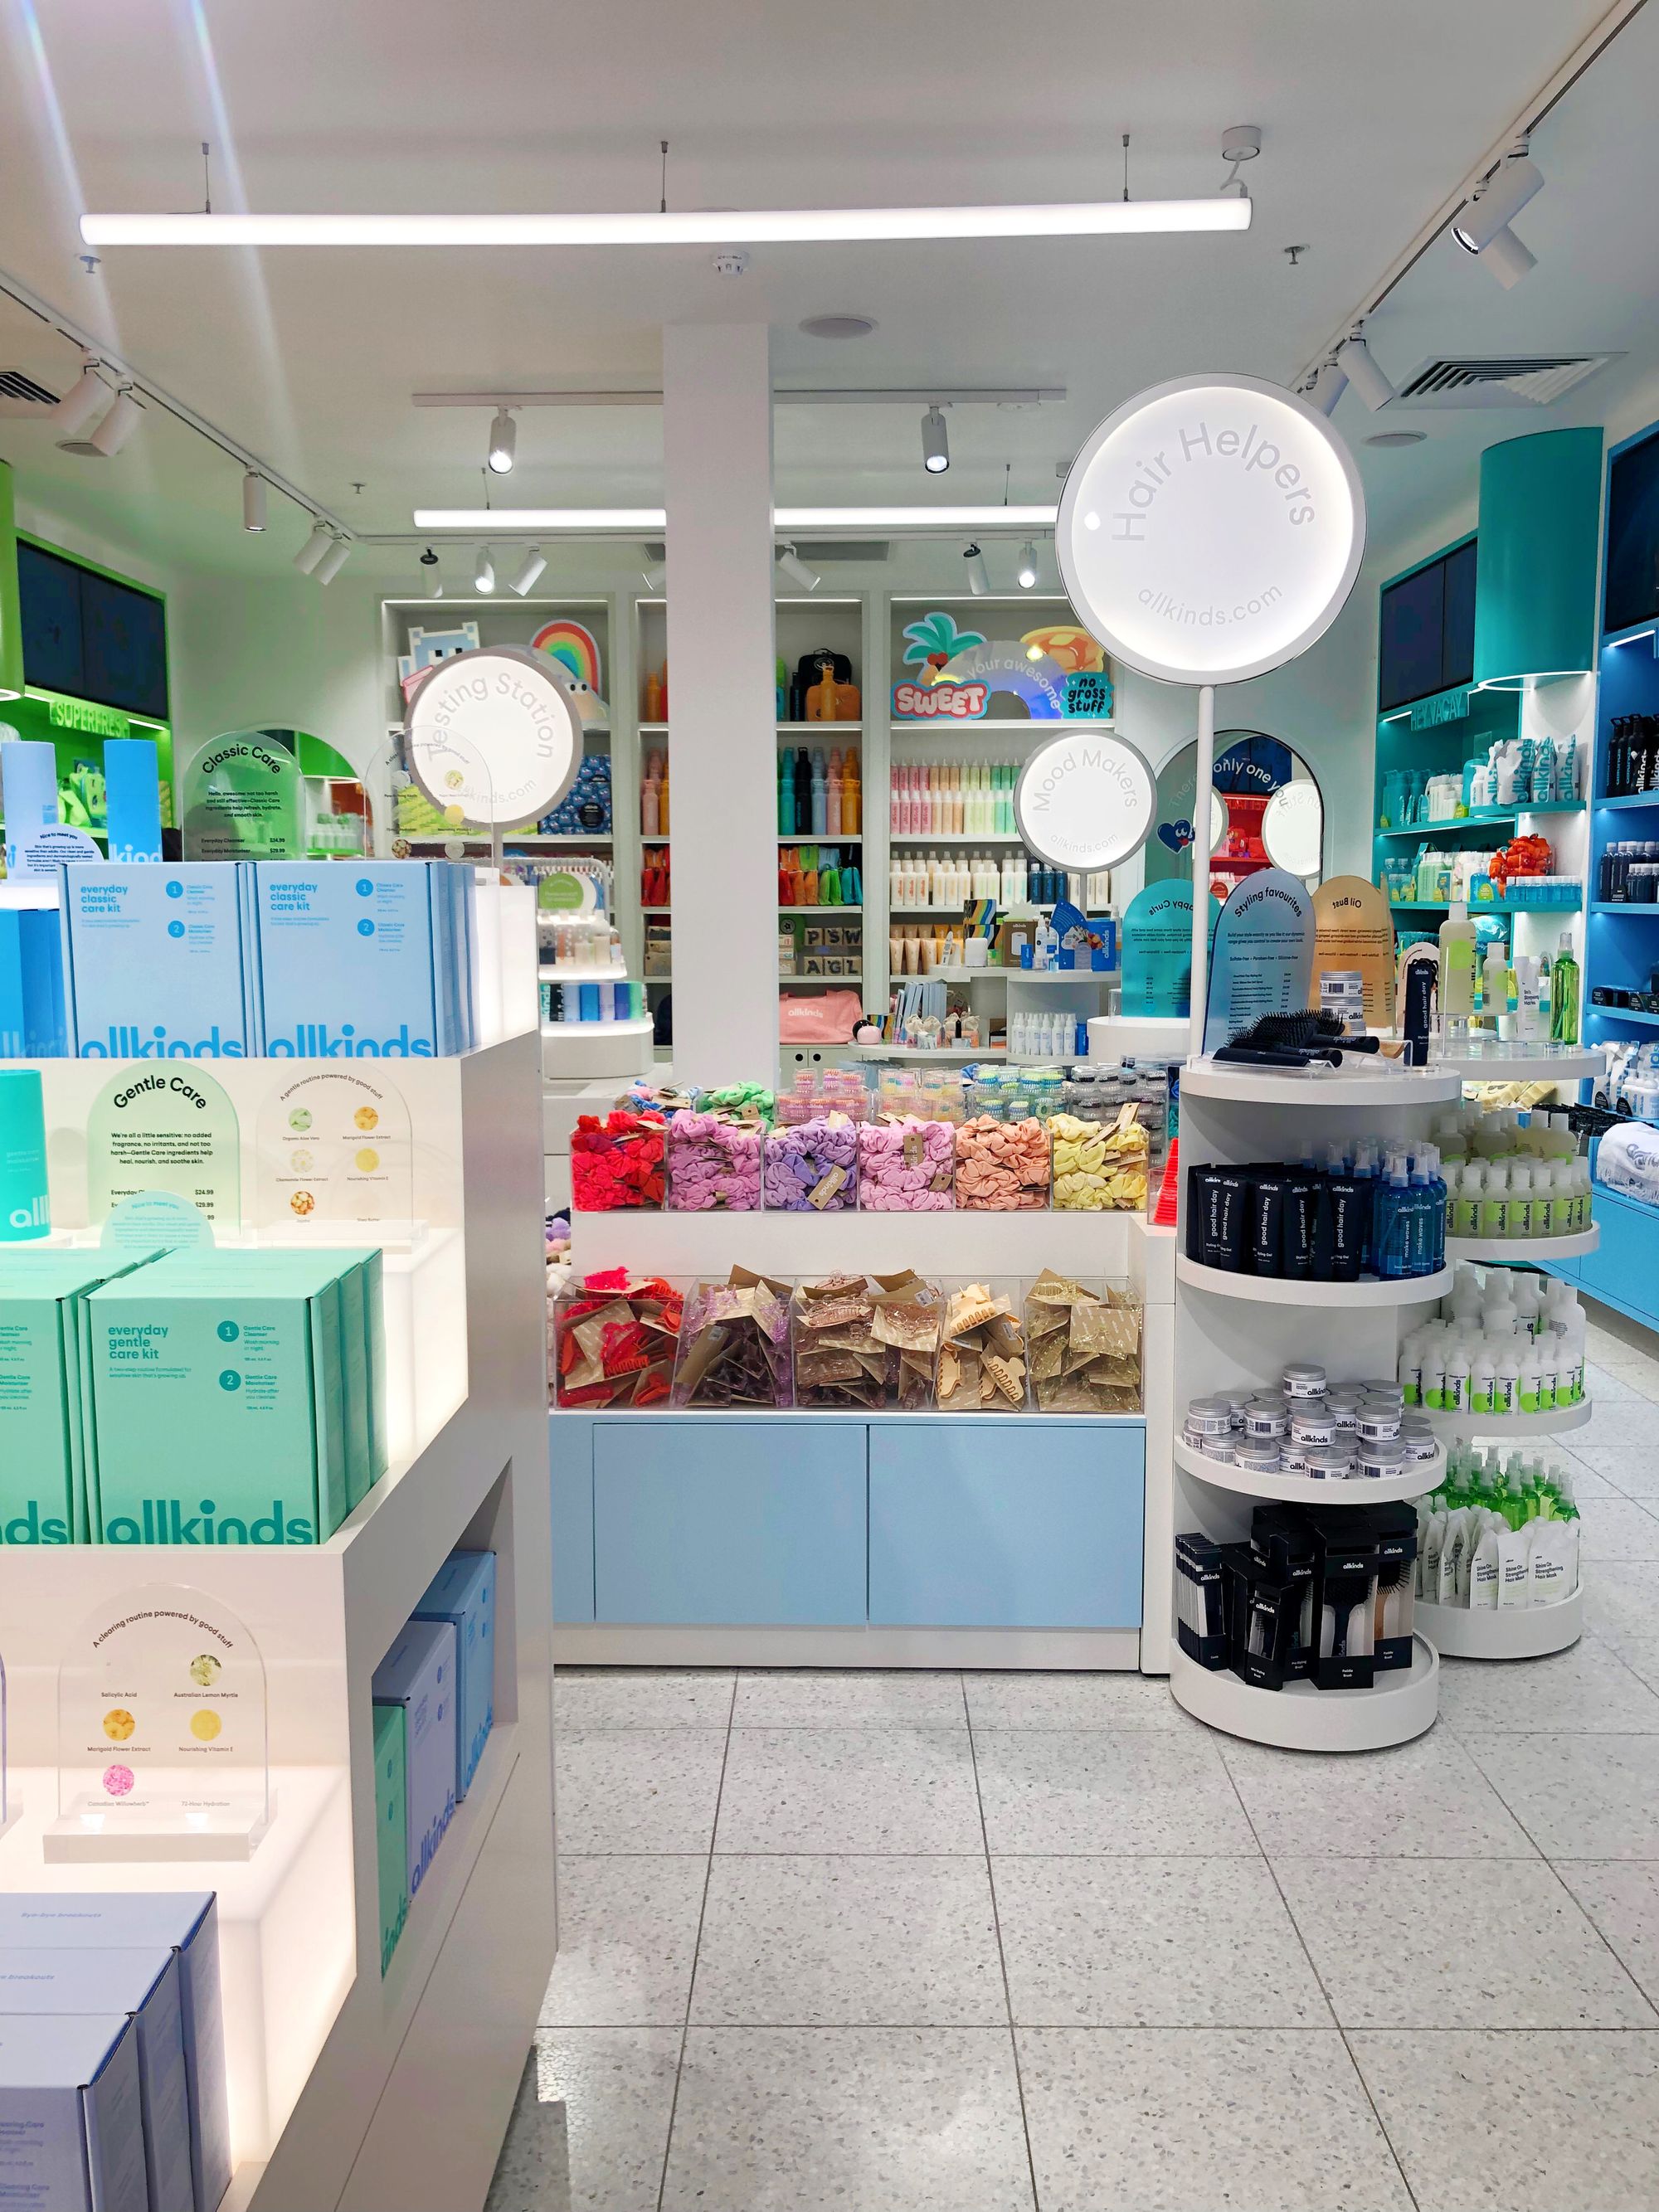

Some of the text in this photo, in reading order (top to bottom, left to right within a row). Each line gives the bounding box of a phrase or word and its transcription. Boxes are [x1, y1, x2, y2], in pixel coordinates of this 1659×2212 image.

[1112, 422, 1315, 541] Hair Helpers
[1138, 585, 1282, 625] allkinds.com
[967, 658, 1060, 710] your awesome
[1079, 678, 1096, 688] no
[897, 687, 984, 715] SWEET
[1068, 688, 1105, 702] gross
[1068, 701, 1105, 714] stuff
[428, 673, 556, 761] Testing Station
[202, 743, 280, 774] Classic Care
[1033, 749, 1137, 812] Mood Makers
[1214, 758, 1244, 775] only
[1247, 764, 1272, 784] one
[1267, 781, 1289, 807] you
[1050, 834, 1118, 853] allkinds.com
[80, 884, 128, 895] everyday
[270, 882, 318, 893] everyday
[80, 894, 116, 903] classic
[270, 892, 306, 902] classic
[1234, 887, 1302, 918] Styling favourites
[81, 903, 121, 913] care kit
[271, 901, 310, 911] care kit
[788, 1008, 824, 1018] allkinds
[114, 1075, 207, 1109] Gentle Care
[285, 1082, 300, 1098] gentle
[300, 1075, 320, 1086] routine
[356, 1078, 371, 1091] good
[370, 1087, 383, 1100] stuff
[819, 1172, 839, 1197] allkinds
[1259, 1184, 1279, 1192] allkinds
[1332, 1185, 1354, 1194] allkinds
[1211, 1189, 1219, 1203] day
[1262, 1197, 1271, 1211] day
[1338, 1199, 1346, 1213] day
[1210, 1218, 1219, 1237] good
[108, 1324, 168, 1338] everyday
[109, 1336, 150, 1349] gentle
[109, 1348, 159, 1359] care kit
[1301, 1435, 1328, 1444] allkinds
[106, 1500, 313, 1544] allkinds
[1343, 1562, 1364, 1570] allkinds
[1255, 1602, 1275, 1614] allkinds
[98, 1619, 126, 1643] clearing
[126, 1611, 153, 1623] routine
[154, 1610, 188, 1620] powered
[189, 1614, 199, 1625] by
[199, 1621, 218, 1636] good
[216, 1631, 234, 1650] stuff
